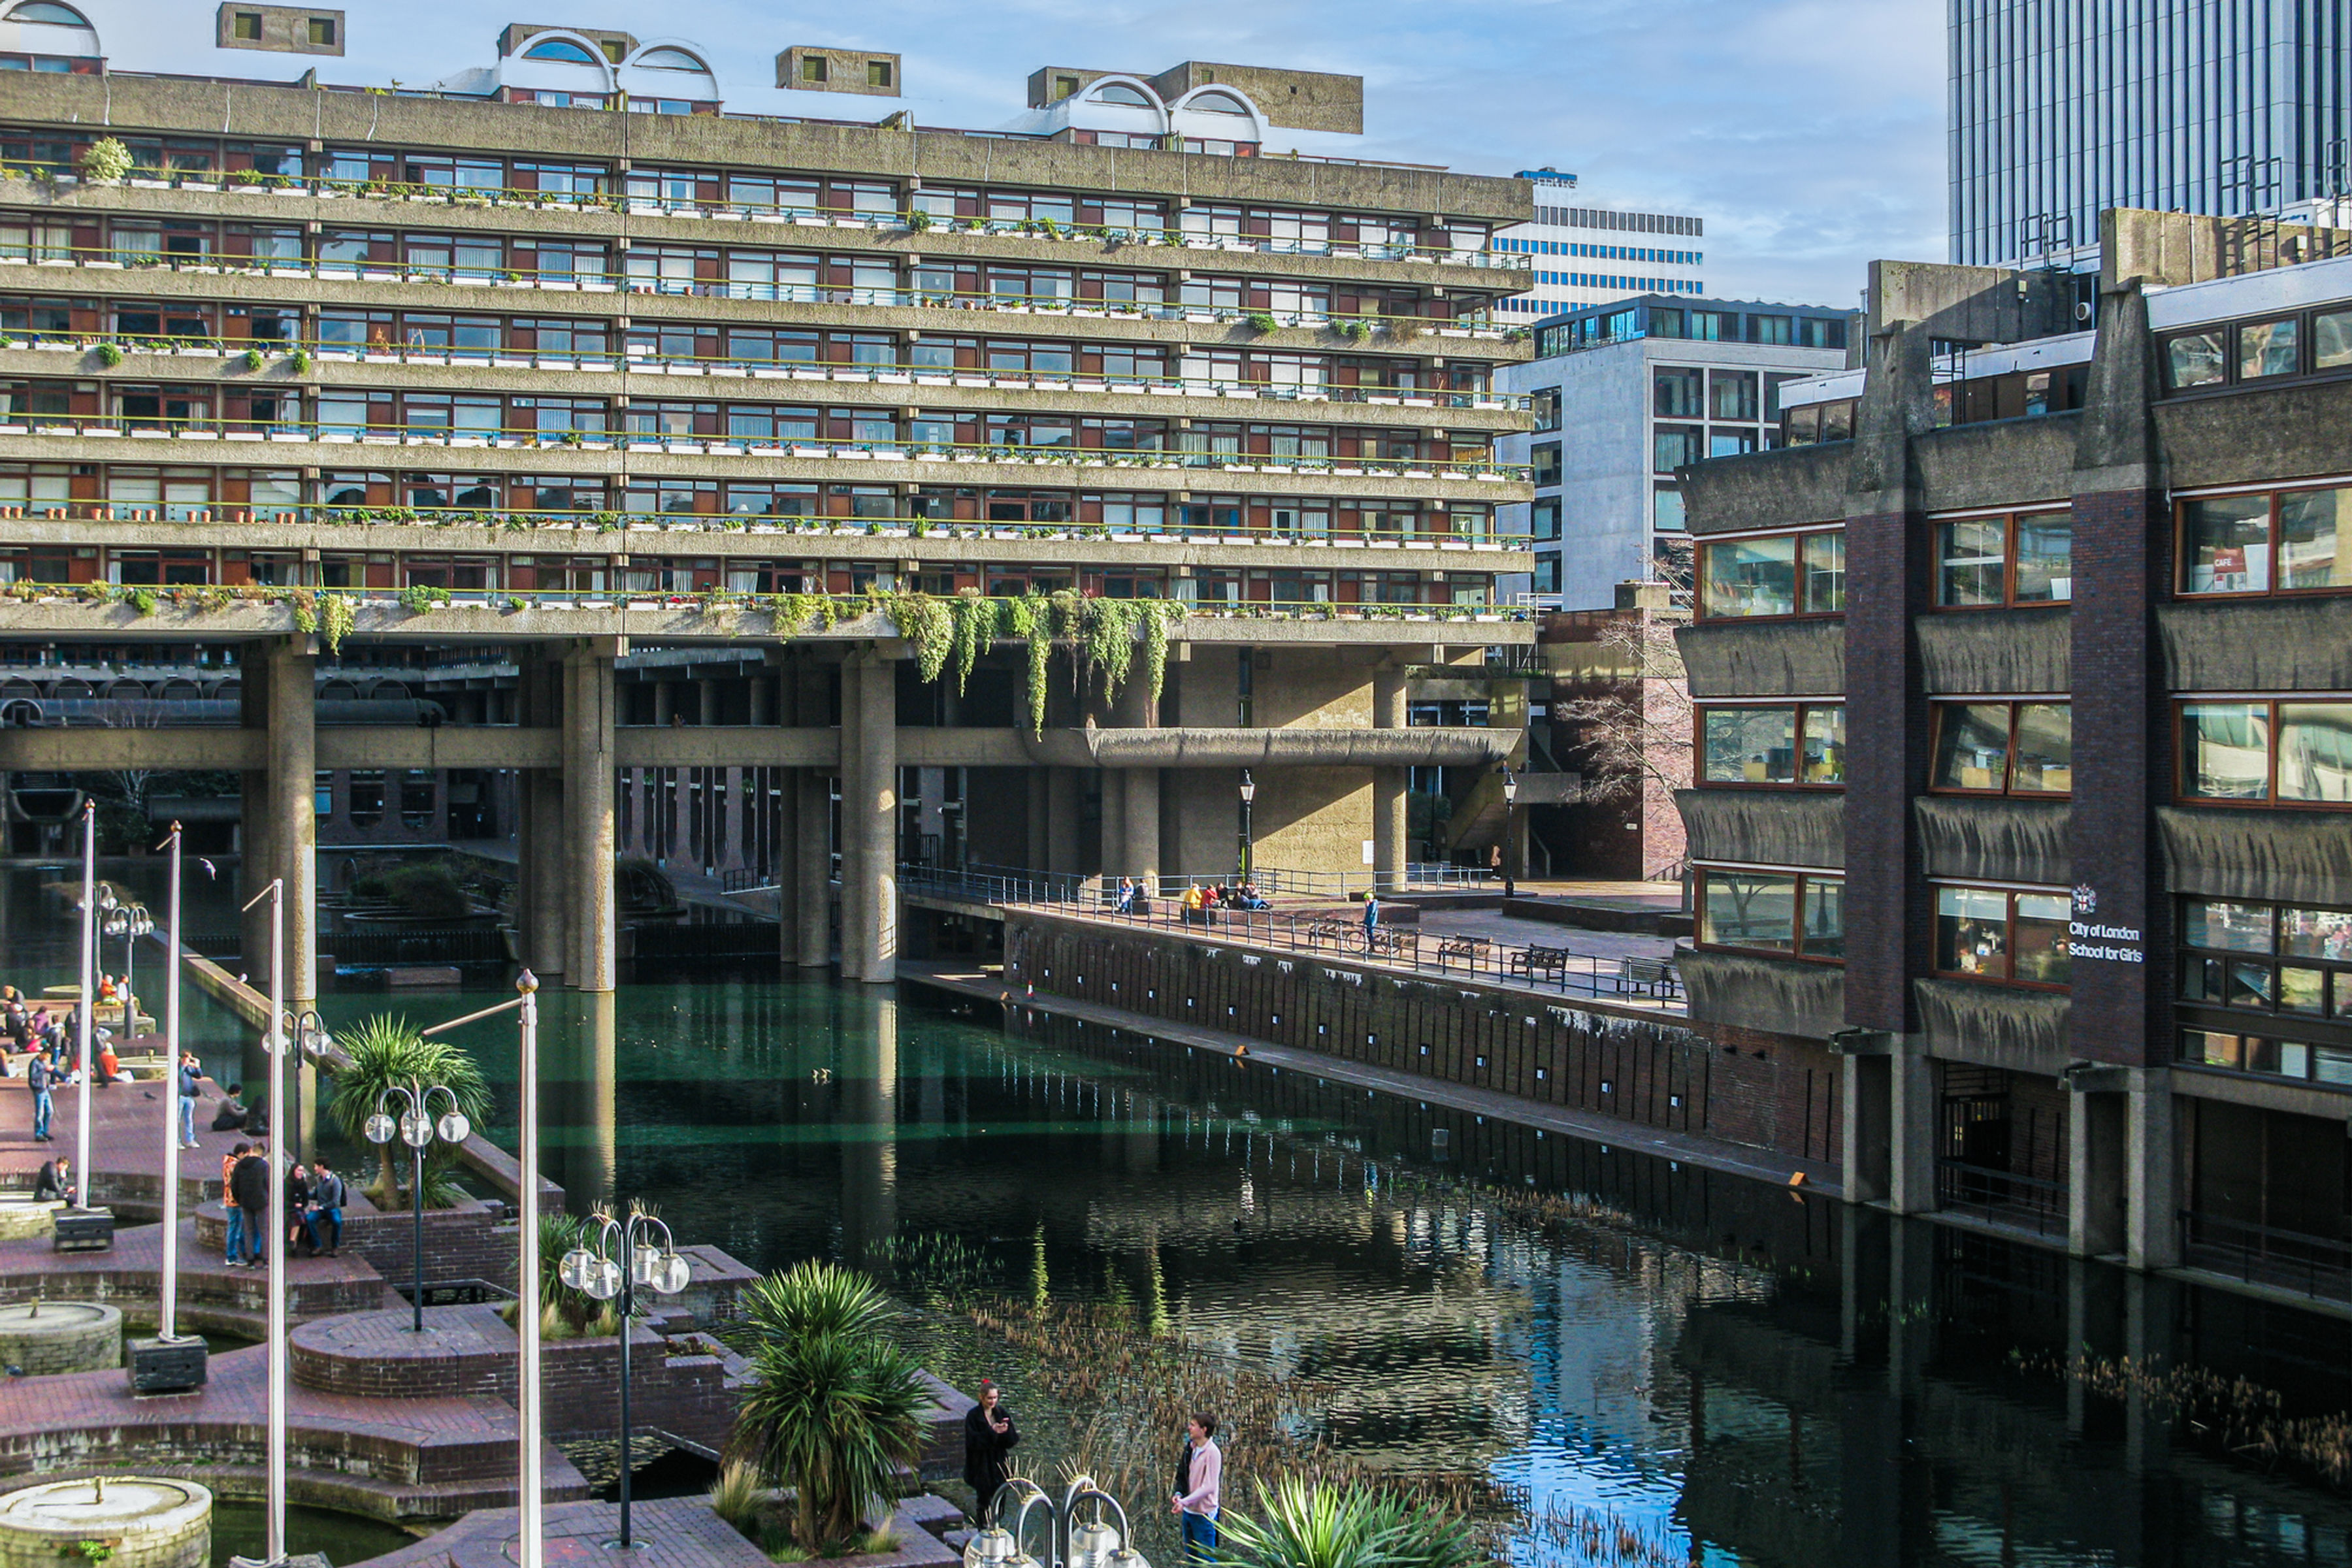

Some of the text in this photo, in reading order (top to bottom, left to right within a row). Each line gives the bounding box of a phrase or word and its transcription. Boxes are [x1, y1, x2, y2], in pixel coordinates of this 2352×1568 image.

[2068, 922, 2140, 941] City of London
[2068, 942, 2143, 963] School for Girls
